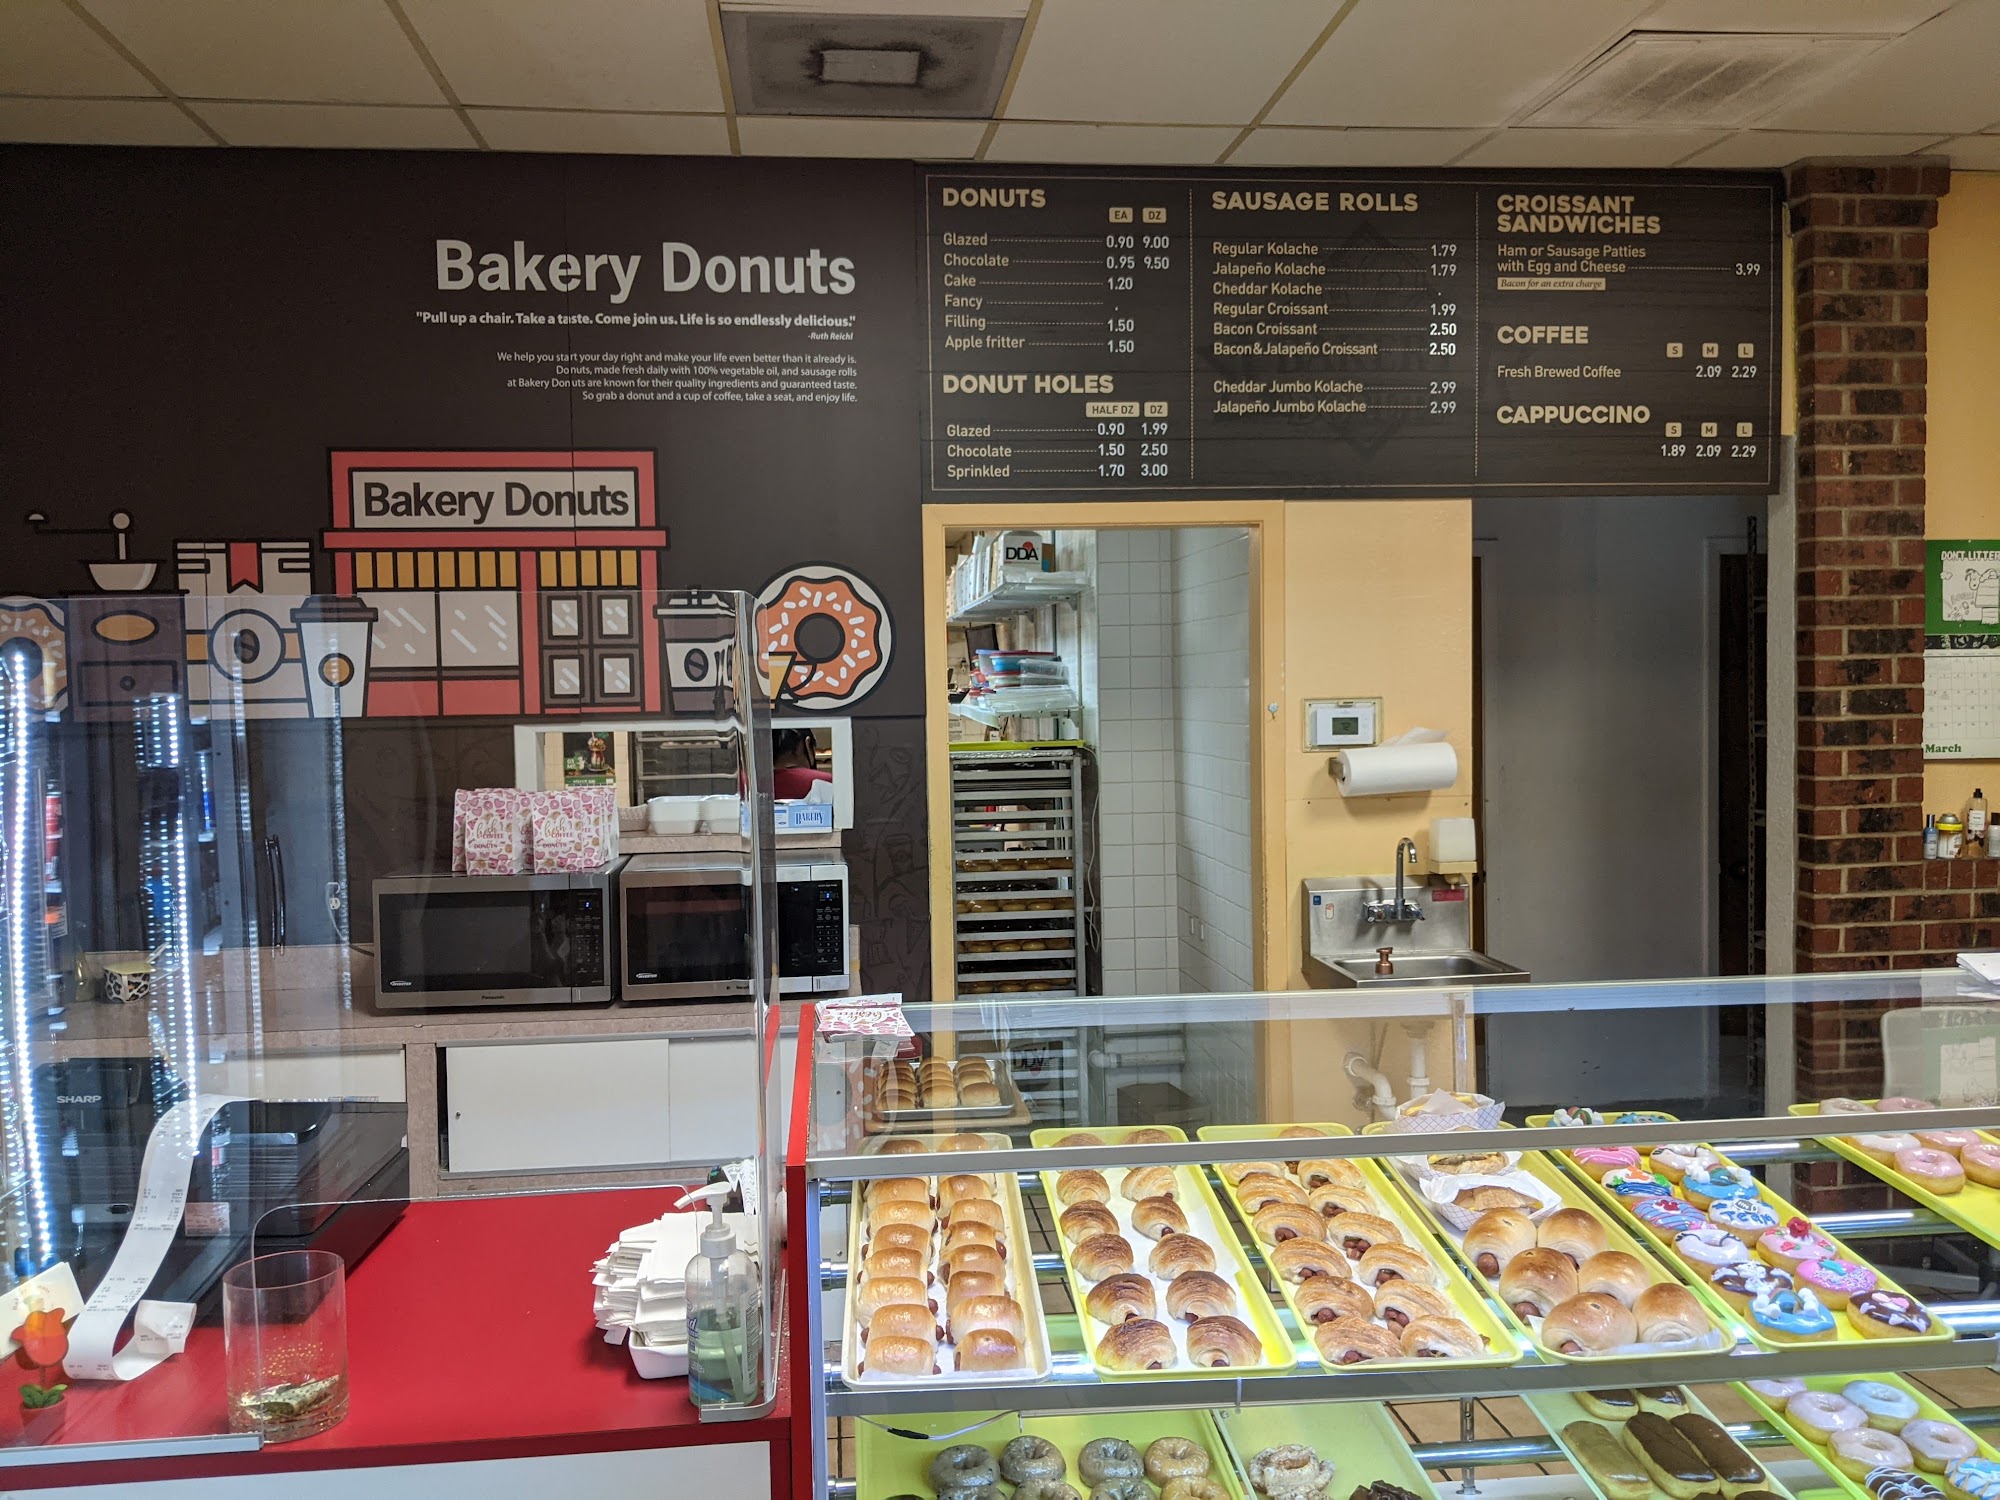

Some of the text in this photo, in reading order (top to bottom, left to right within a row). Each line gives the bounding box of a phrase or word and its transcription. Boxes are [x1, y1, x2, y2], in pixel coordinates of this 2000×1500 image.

[943, 188, 1046, 208] DONUTS
[1212, 191, 1418, 211] SAUSAGE ROLLS
[1497, 195, 1634, 214] CROISSANT
[1115, 210, 1161, 220] EA DZ
[1497, 214, 1660, 234] SANDWICHES
[944, 233, 1169, 248] Glazed 0.90 9.00
[1213, 242, 1457, 257] Regular Kolache 1.79
[1498, 244, 1646, 259] Ham or Sausage Patties
[944, 253, 1169, 269] Chocolate 0.95 9.50
[1497, 259, 1760, 275] with Egg and Cheese 3.99
[437, 240, 855, 304] Bakery Donuts
[1213, 262, 1456, 277] Jalapeño Kolache 1.79
[944, 274, 1133, 290] Cake 1.20
[1213, 282, 1322, 295] Cheddar Kolache
[1501, 279, 1526, 287] Bacon
[1526, 279, 1539, 289] for
[1576, 279, 1602, 289] charge
[945, 294, 982, 310] Fancy
[1214, 302, 1456, 318] Regular Croissant 1.99
[450, 315, 466, 326] up
[469, 315, 477, 323] a
[479, 312, 514, 323] chair.
[515, 313, 545, 324] Take
[548, 316, 555, 324] a
[557, 314, 593, 324] taste.
[595, 313, 631, 324] Come
[632, 313, 657, 327] join
[660, 316, 678, 325] us.
[680, 313, 703, 325] Life
[705, 314, 715, 325] is
[718, 316, 732, 325] so
[734, 314, 792, 329] endlessly
[945, 315, 1134, 332] Filling 1.50
[830, 332, 853, 340] Reichl
[1214, 322, 1456, 335] Bacon Croissant 2.50
[1497, 326, 1588, 344] COFFEE
[945, 335, 1134, 352] Apple fritter 1.50
[1322, 342, 1378, 355] Croissant
[1430, 343, 1456, 355] 2.50
[497, 352, 512, 361] We
[514, 352, 535, 363] help
[537, 355, 554, 363] you
[556, 353, 578, 361] start
[579, 354, 600, 363] your
[602, 352, 618, 363] day
[621, 352, 642, 364] right
[645, 352, 662, 361] and
[664, 352, 689, 362] make
[691, 355, 711, 364] your
[714, 352, 727, 362] life
[753, 353, 781, 363] better
[782, 353, 803, 363] than
[805, 354, 811, 363] it
[813, 354, 846, 366] already
[847, 355, 857, 364] is.
[557, 365, 857, 378] Donuts, made fresh daily with 100% vegetable oil, and sausage rolls
[1498, 365, 1757, 378] Fresh Brewed Coffee 2.09 2.29
[508, 379, 516, 387] at
[519, 378, 549, 389] Bakery
[552, 378, 585, 387] Donuts
[604, 378, 635, 388] known
[637, 378, 650, 387] for
[652, 379, 673, 388] their
[675, 378, 706, 390] quality
[708, 379, 759, 391] ingredients
[761, 380, 778, 389] and
[780, 380, 831, 391] guaranteed
[833, 381, 857, 390] taste.
[943, 375, 1113, 393] DONUT HOLES
[1214, 380, 1456, 394] Cheddar Jumbo Kolache 2.99
[1092, 405, 1163, 414] HALF DZ DZ
[1213, 400, 1456, 416] Jalapeño Jumbo Kolache 2.99
[1497, 406, 1650, 423] CAPPUCCINO
[947, 423, 1167, 437] Glazed 0.90 1.99
[947, 443, 1167, 457] Chocolate 1.50 2.50
[1661, 444, 1756, 457] 1.89 2.09 2.29
[948, 464, 1168, 480] Sprinkled 1.70 3.00
[364, 482, 629, 525] Bakery Donuts
[1005, 547, 1039, 560] DDA
[1925, 744, 1962, 753] March
[796, 812, 823, 824] BAKERY
[56, 1095, 102, 1103] SHARP
